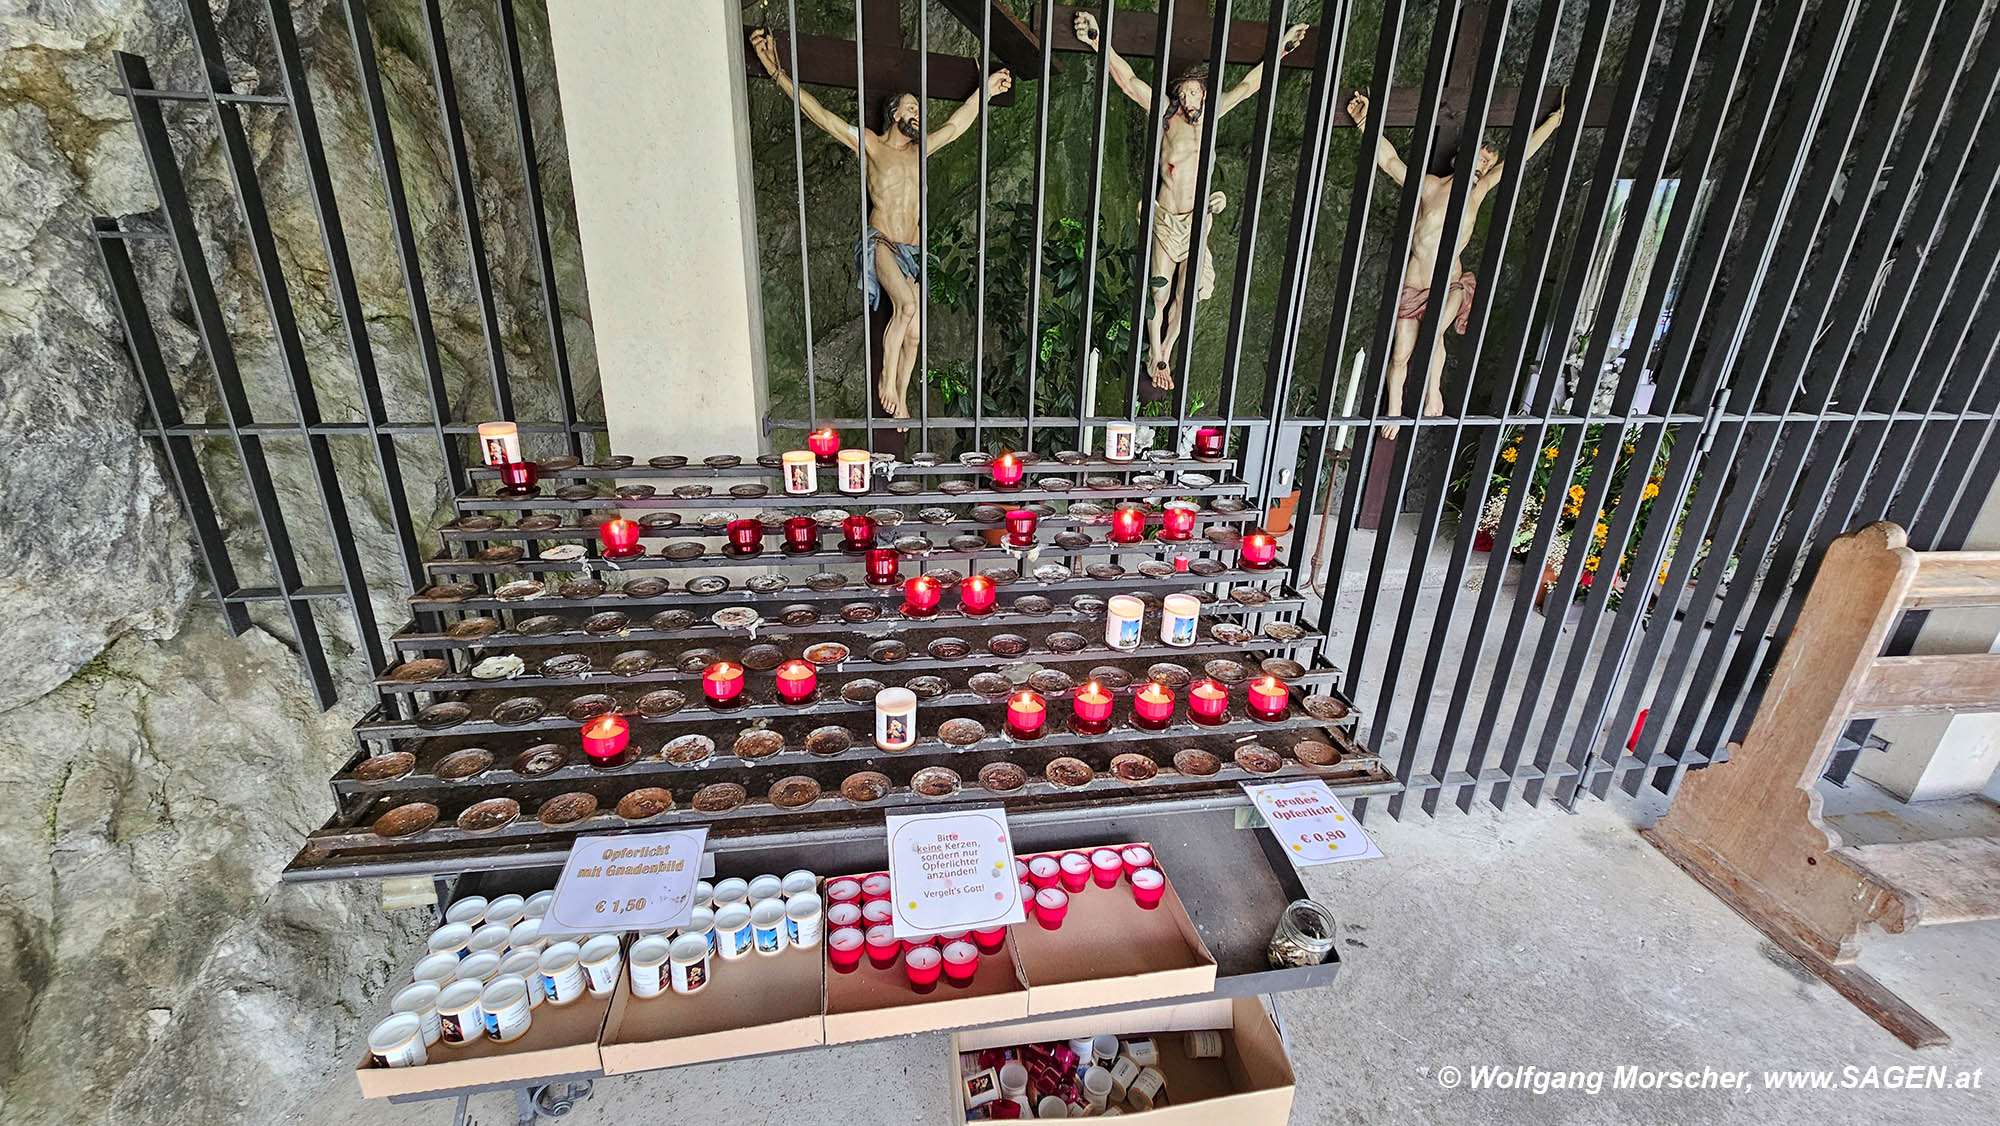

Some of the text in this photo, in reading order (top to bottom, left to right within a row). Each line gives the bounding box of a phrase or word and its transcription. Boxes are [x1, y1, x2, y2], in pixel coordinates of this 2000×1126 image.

[1275, 796, 1319, 808] großes
[1272, 805, 1337, 820] Opferlicht
[937, 834, 958, 842] Bitte
[1300, 830, 1346, 844] € 0,80
[602, 843, 671, 862] Opferlicht
[917, 840, 981, 852] keine Kerzen,
[921, 849, 978, 861] sondern nur
[577, 860, 685, 878] mit Gnadenbild
[922, 858, 979, 871] Opferlichter
[963, 884, 985, 893] Gott!
[595, 898, 647, 914] € 1,50
